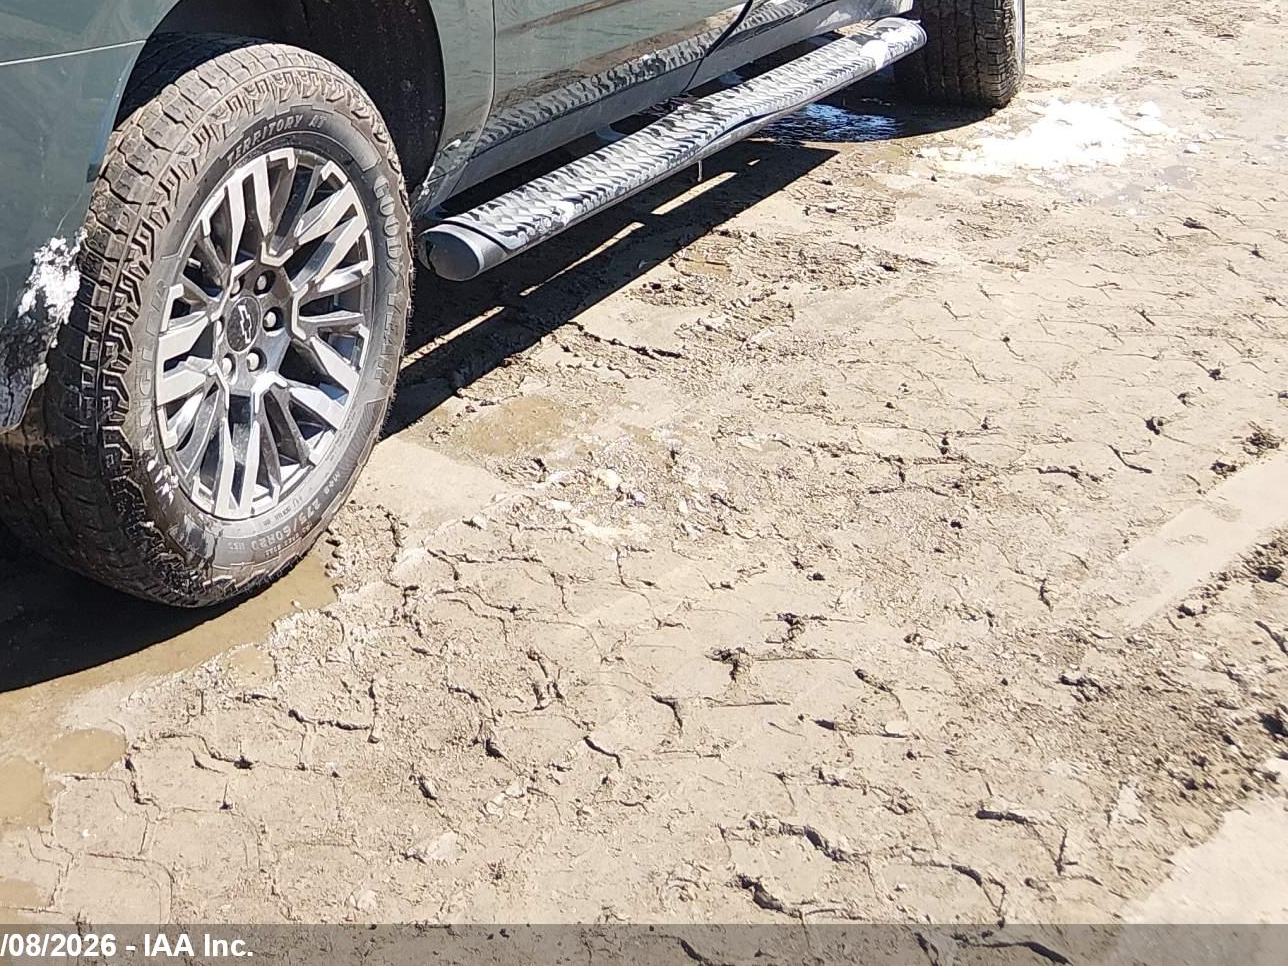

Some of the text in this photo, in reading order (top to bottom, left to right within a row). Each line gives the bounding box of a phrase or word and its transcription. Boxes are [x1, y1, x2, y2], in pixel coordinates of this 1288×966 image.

[226, 113, 328, 168] TERRITORY AT
[251, 496, 322, 552] 275/60R20
